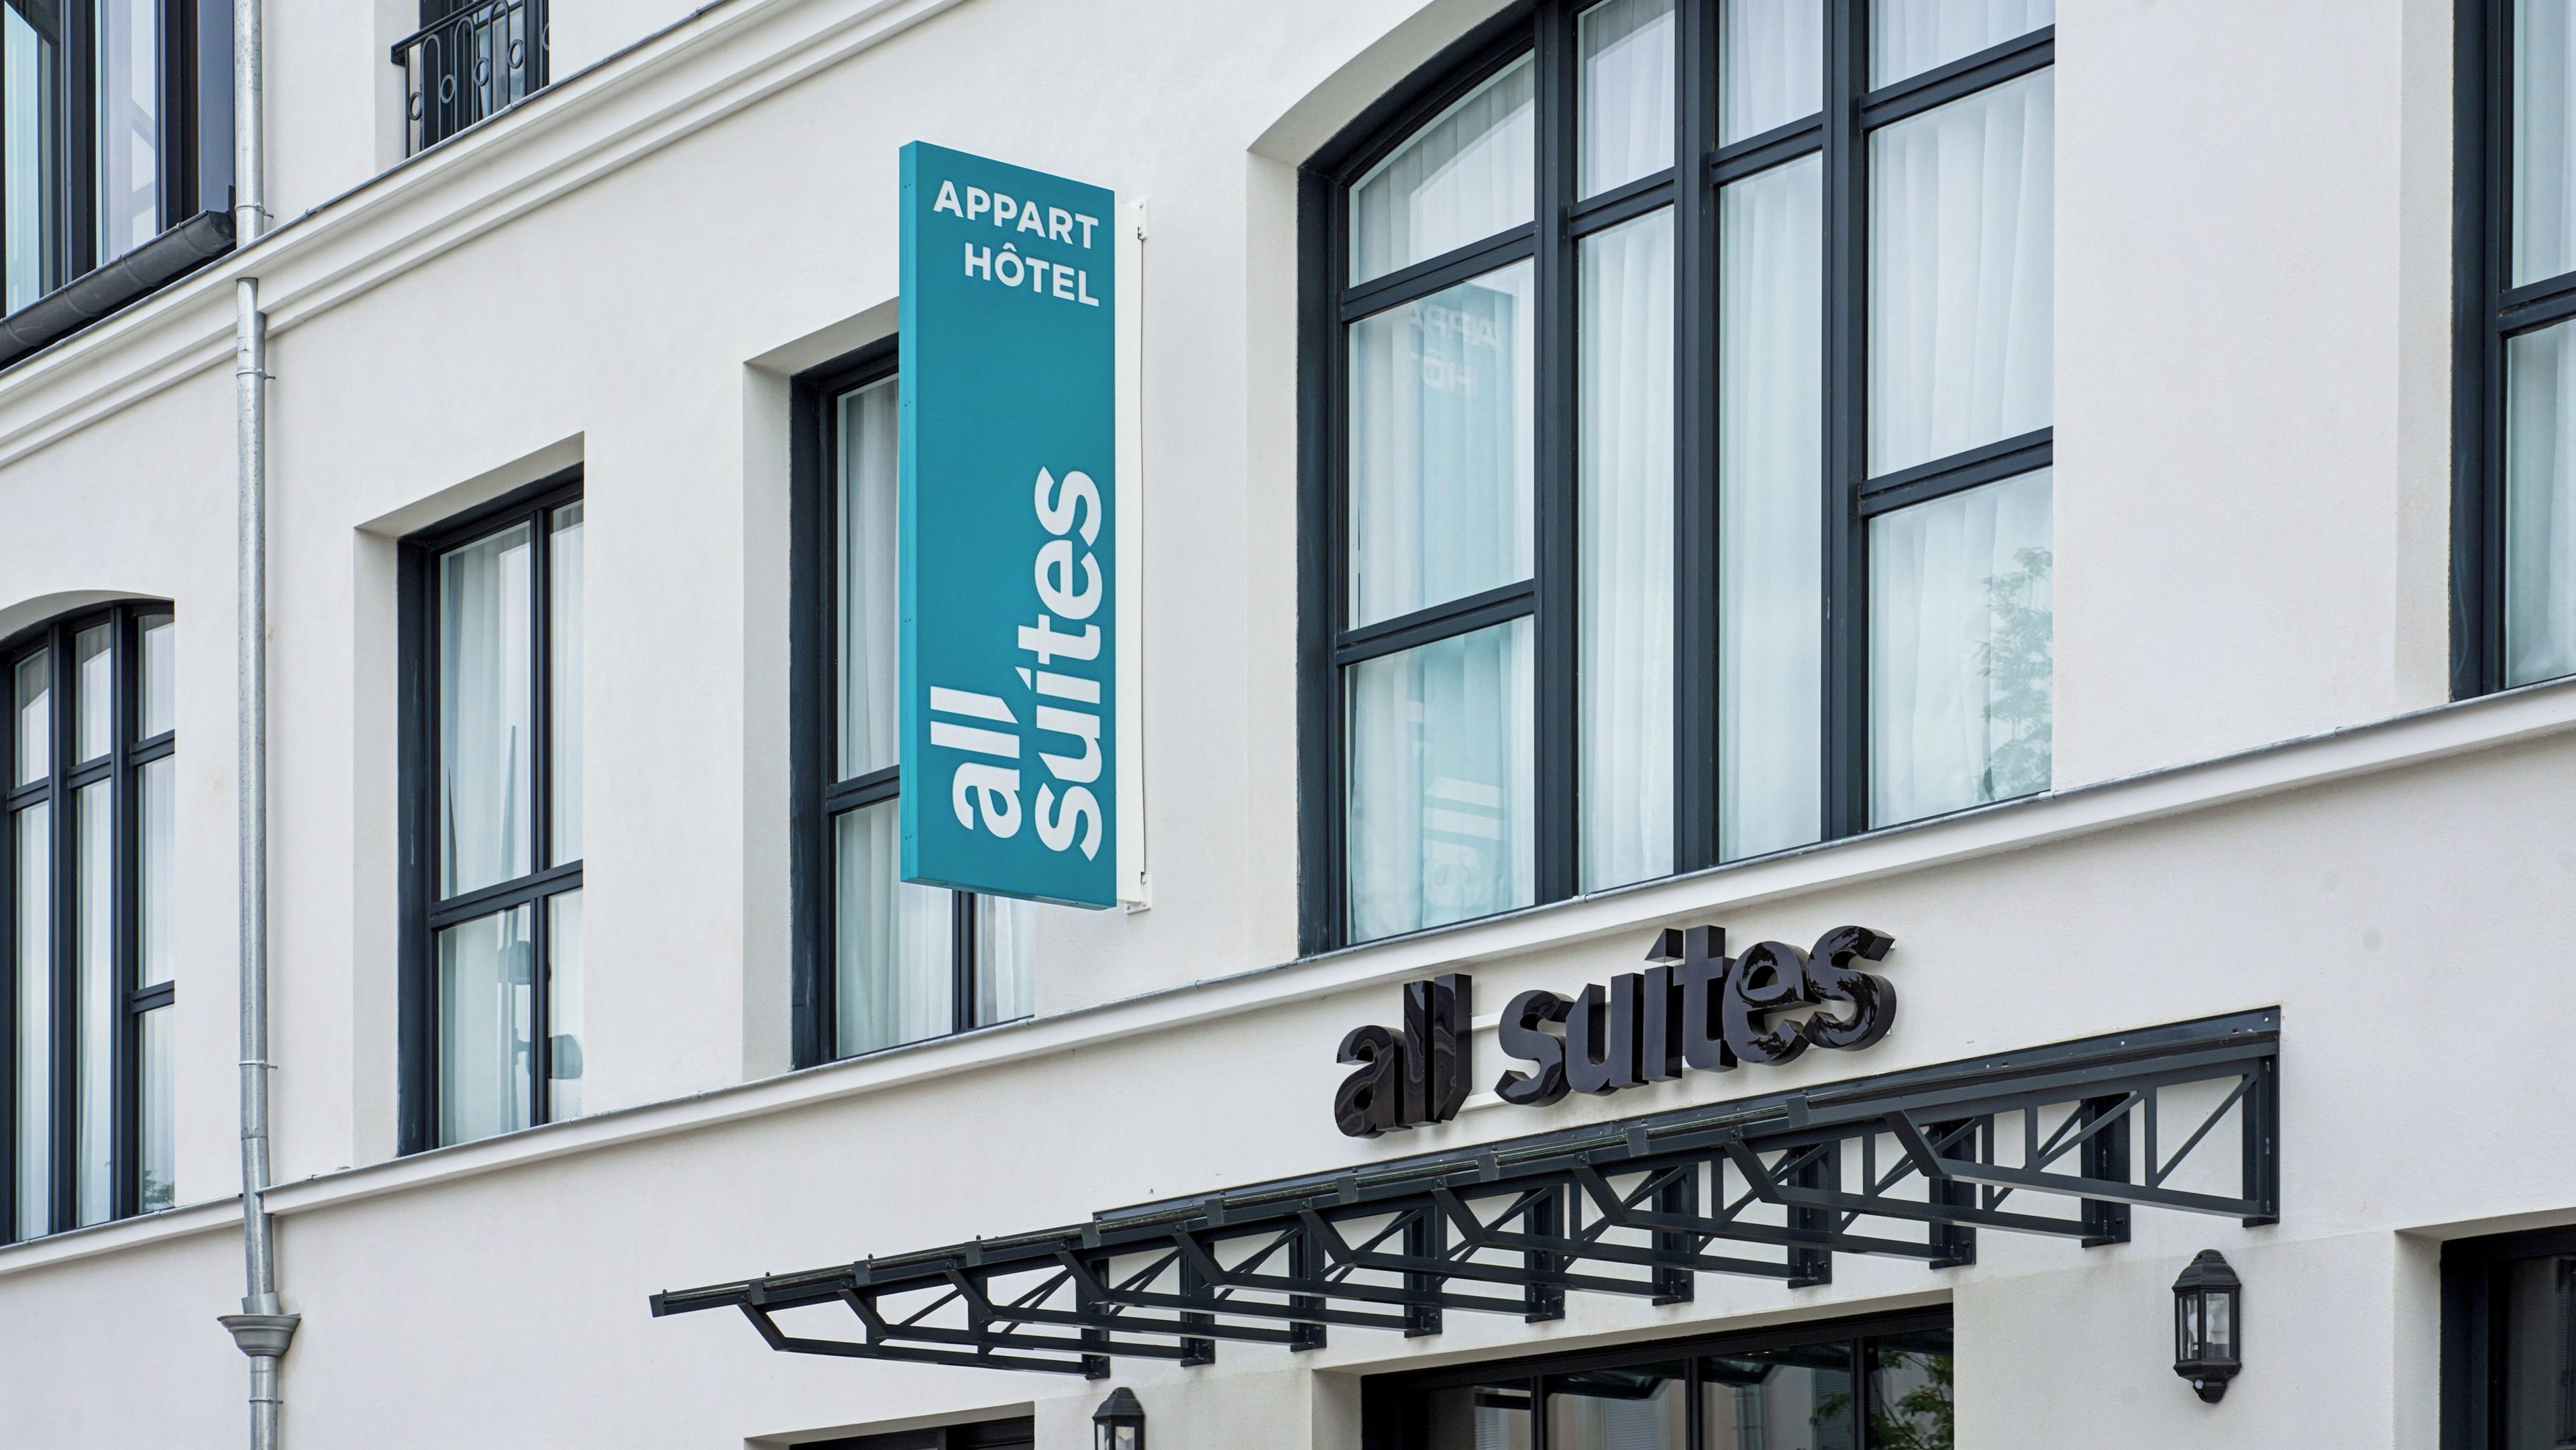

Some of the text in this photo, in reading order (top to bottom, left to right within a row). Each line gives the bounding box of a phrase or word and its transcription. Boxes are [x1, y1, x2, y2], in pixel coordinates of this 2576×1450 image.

[933, 180, 1099, 250] APPART
[965, 242, 1099, 307] HÔTEL
[1014, 466, 1103, 862] suites
[930, 685, 1022, 839] all
[1334, 924, 1898, 1139] all suites
